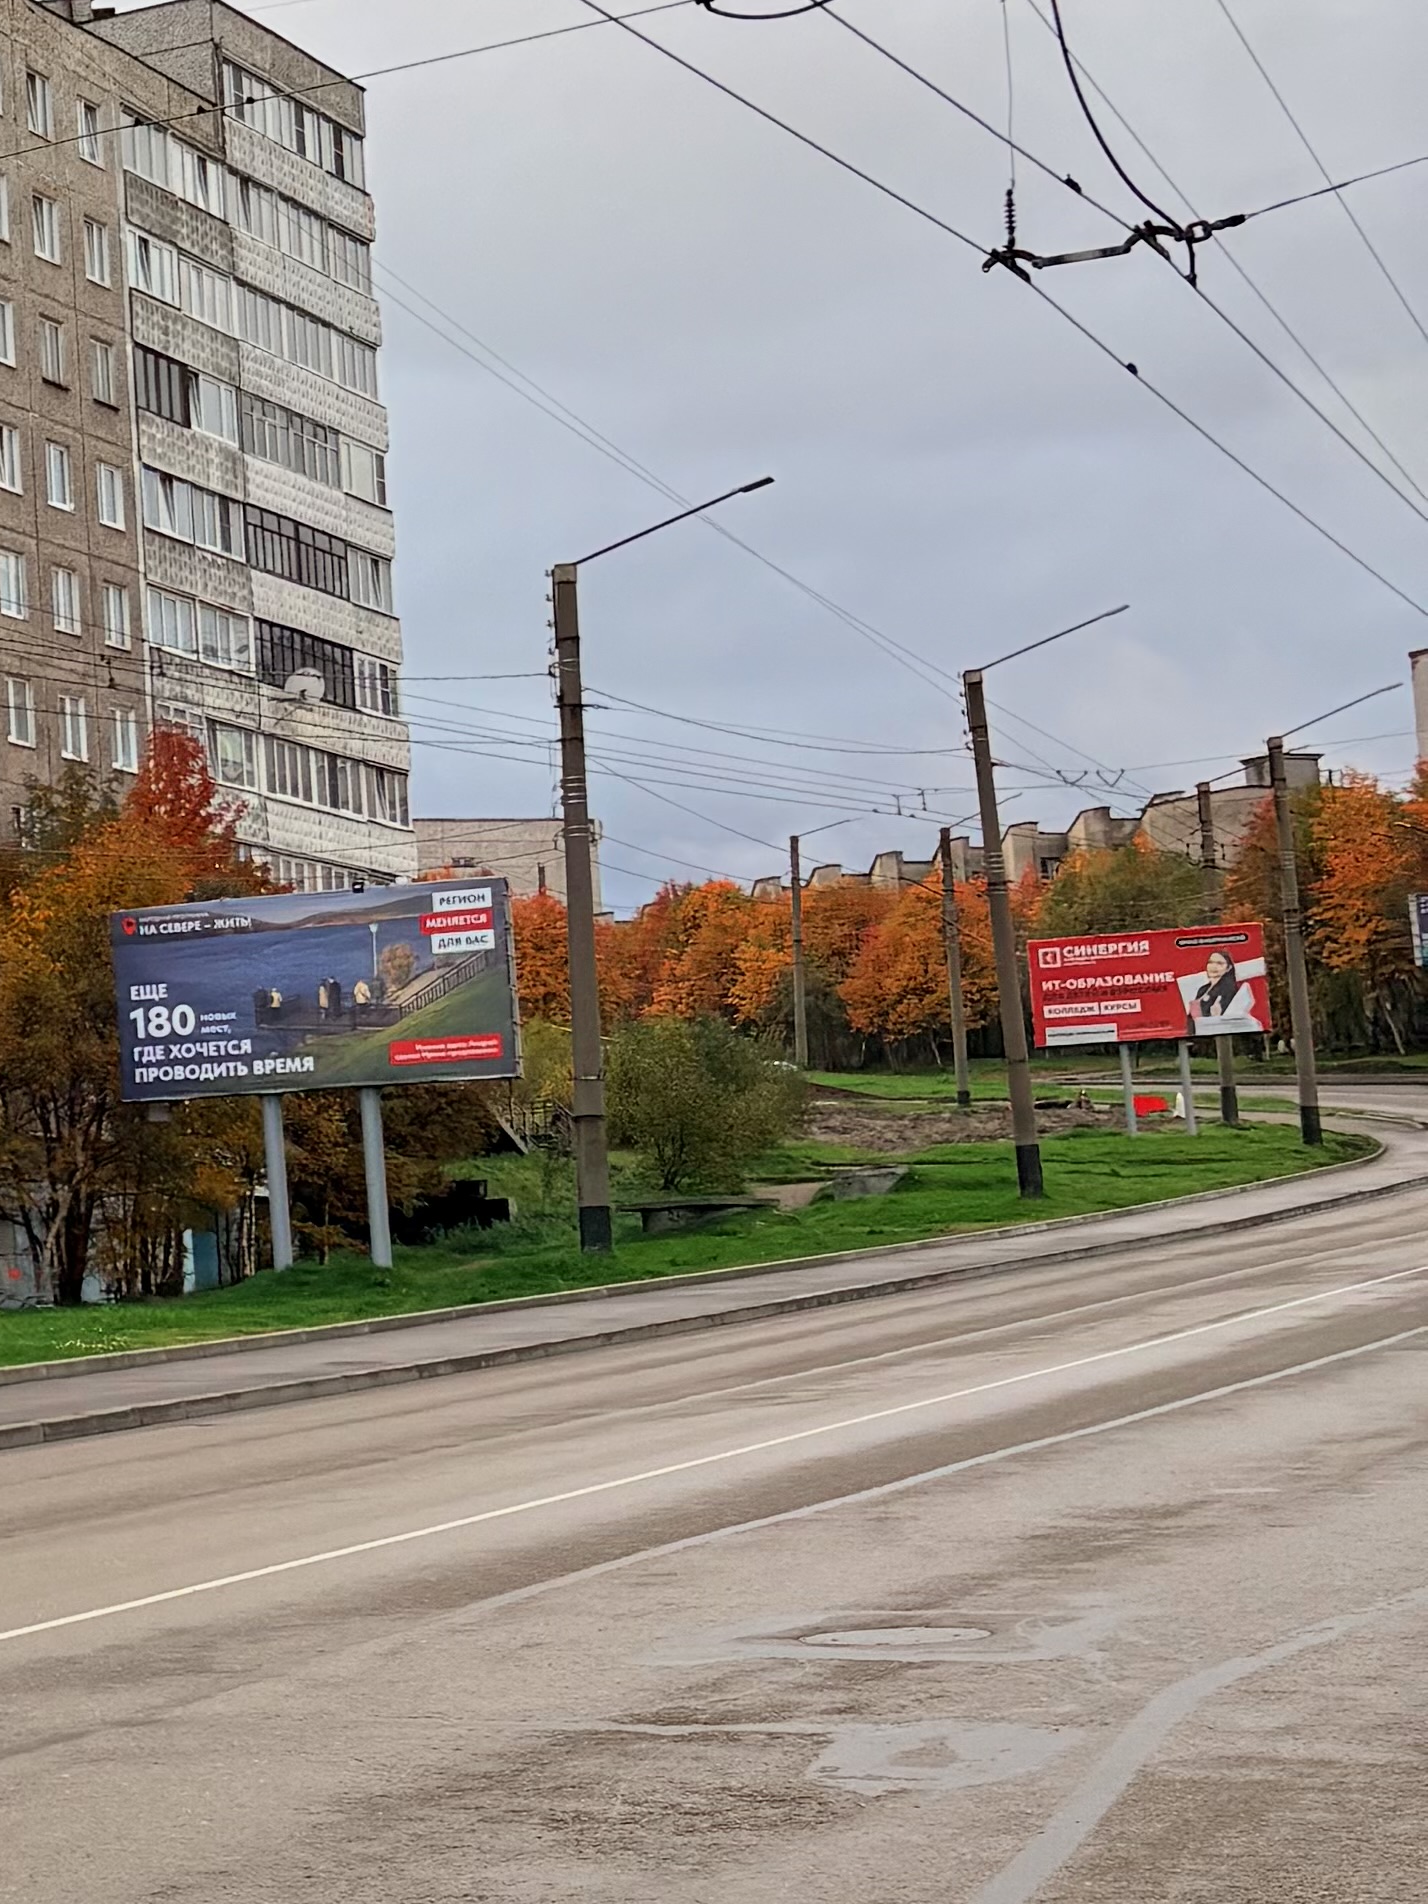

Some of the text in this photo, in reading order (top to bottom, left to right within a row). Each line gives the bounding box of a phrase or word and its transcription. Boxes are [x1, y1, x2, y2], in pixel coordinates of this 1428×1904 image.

[439, 893, 486, 906] РЕГИОН
[139, 924, 157, 936] НА
[159, 920, 203, 934] СЕВЕРЕ
[425, 913, 488, 928] МЕНЯЕТСЯ
[465, 934, 489, 945] ВАС
[1063, 940, 1150, 957] СИНЕРГИЯ
[1041, 971, 1175, 991] ИТ-ОБРАЗОВАНИЕ
[129, 983, 168, 1001] ЕЩЕ
[1103, 1002, 1138, 1011] КУРСЫ
[129, 1004, 196, 1039] 180
[200, 1012, 237, 1022] новых
[133, 1039, 252, 1064] ГДЕ ХОЧЕТСЯ
[134, 1056, 315, 1084] ПРОВОДИТЬ ВРЕМЯ
